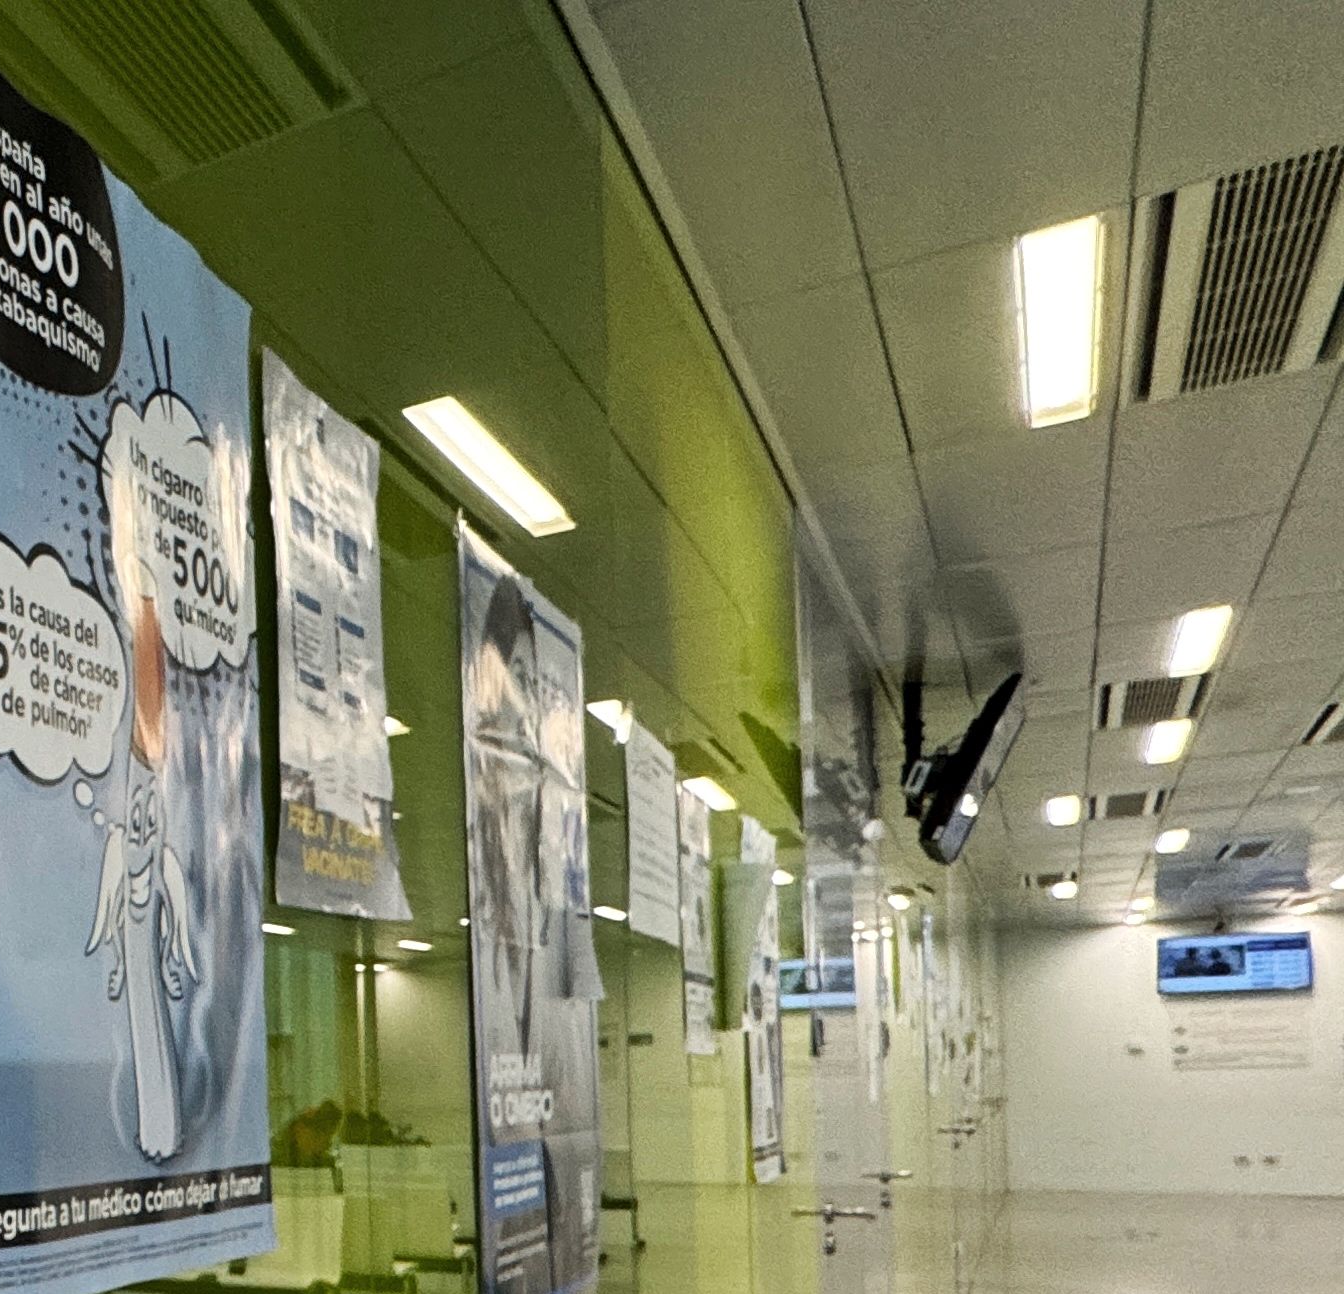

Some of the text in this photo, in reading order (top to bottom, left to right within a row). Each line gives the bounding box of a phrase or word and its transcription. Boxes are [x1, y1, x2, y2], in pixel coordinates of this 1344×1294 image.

[26, 183, 43, 213] al
[49, 196, 83, 236] año
[46, 288, 58, 313] a
[63, 297, 106, 348] causa
[130, 436, 204, 507] Un cigarro
[154, 526, 171, 560] de
[10, 586, 25, 618] la
[29, 601, 71, 638] causa
[75, 618, 99, 649] del
[30, 632, 50, 663] de
[54, 641, 74, 673] los
[77, 656, 119, 690] casos
[2, 686, 26, 717] de
[30, 665, 103, 713] de cáncer
[59, 1202, 69, 1227] a
[71, 1195, 86, 1224] tu
[88, 1186, 142, 1221] médico
[145, 1182, 184, 1214] cómo
